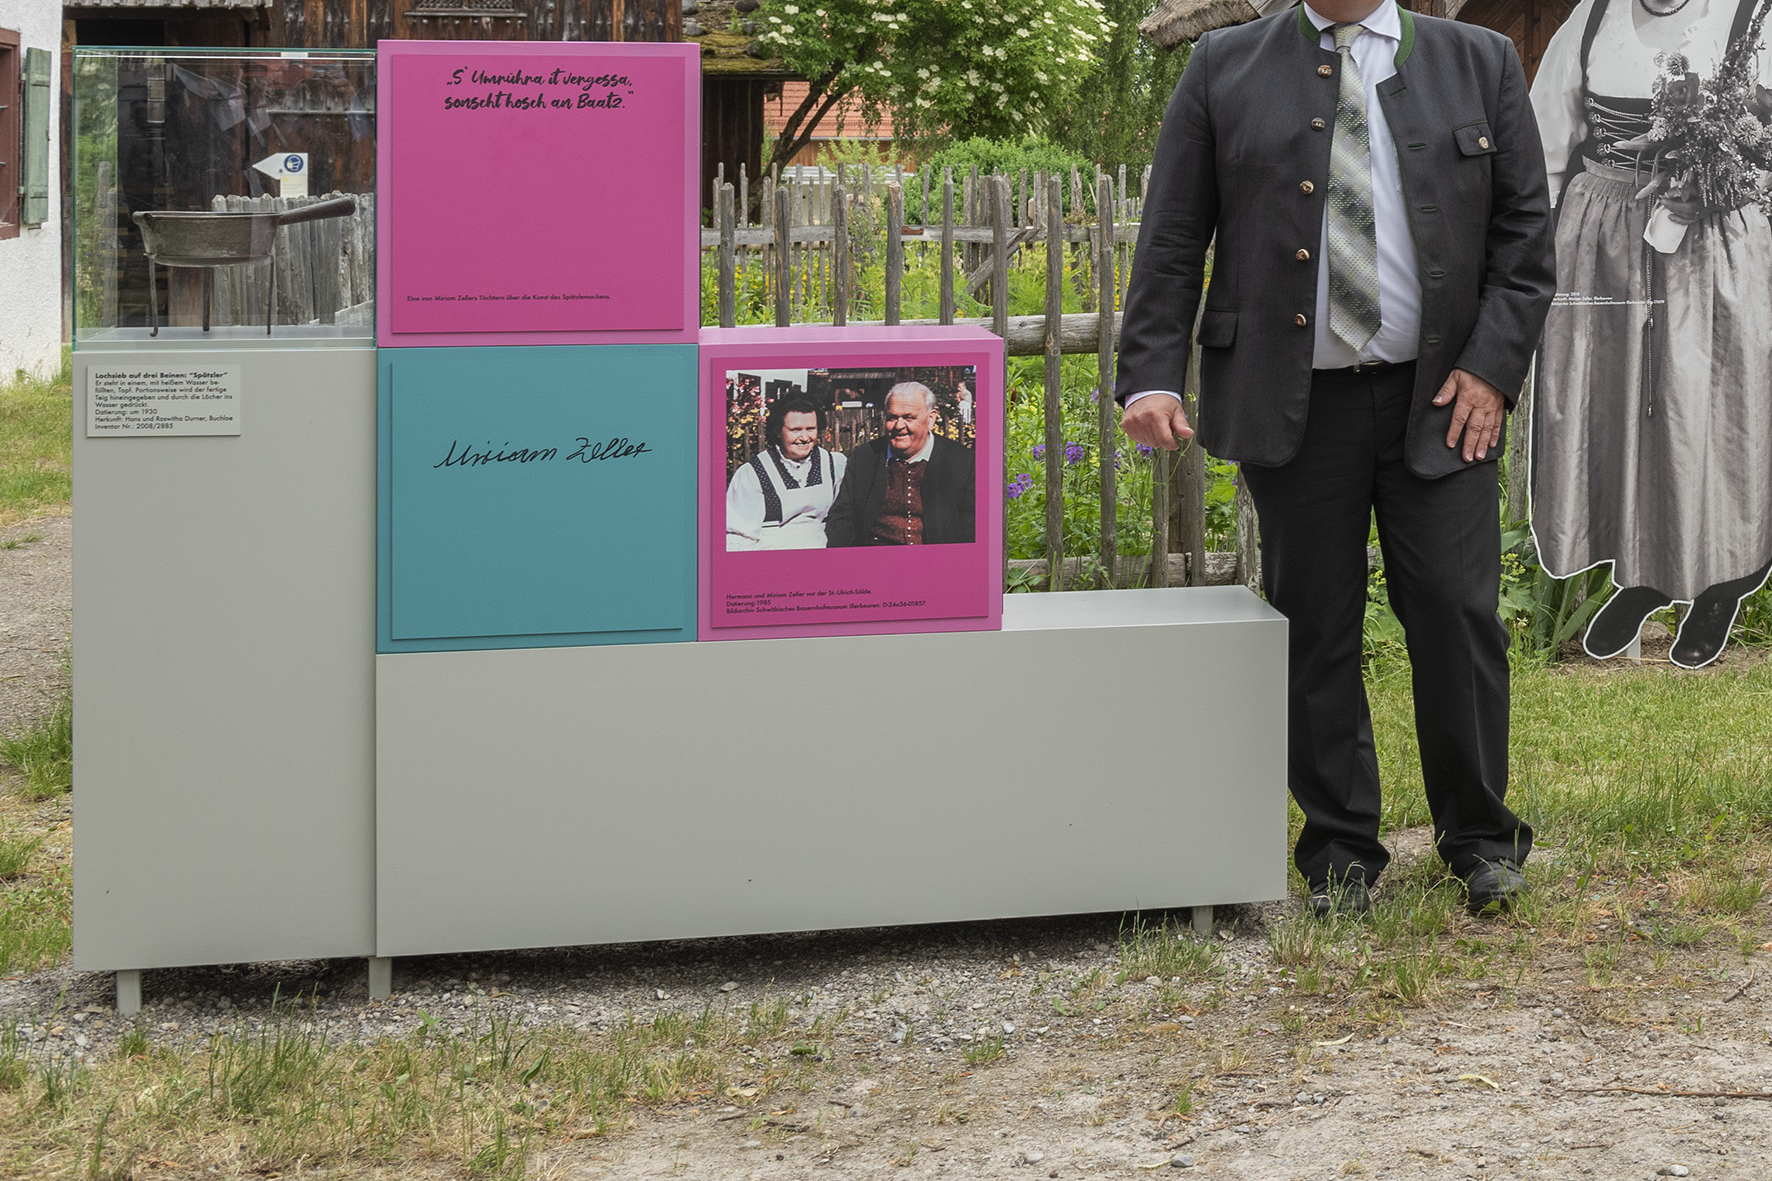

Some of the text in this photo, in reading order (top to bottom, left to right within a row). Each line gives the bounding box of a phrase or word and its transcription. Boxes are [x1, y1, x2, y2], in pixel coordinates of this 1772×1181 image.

[549, 68, 566, 85] it
[445, 91, 507, 110] sonscht
[506, 93, 546, 110] hosch
[551, 99, 572, 109] an
